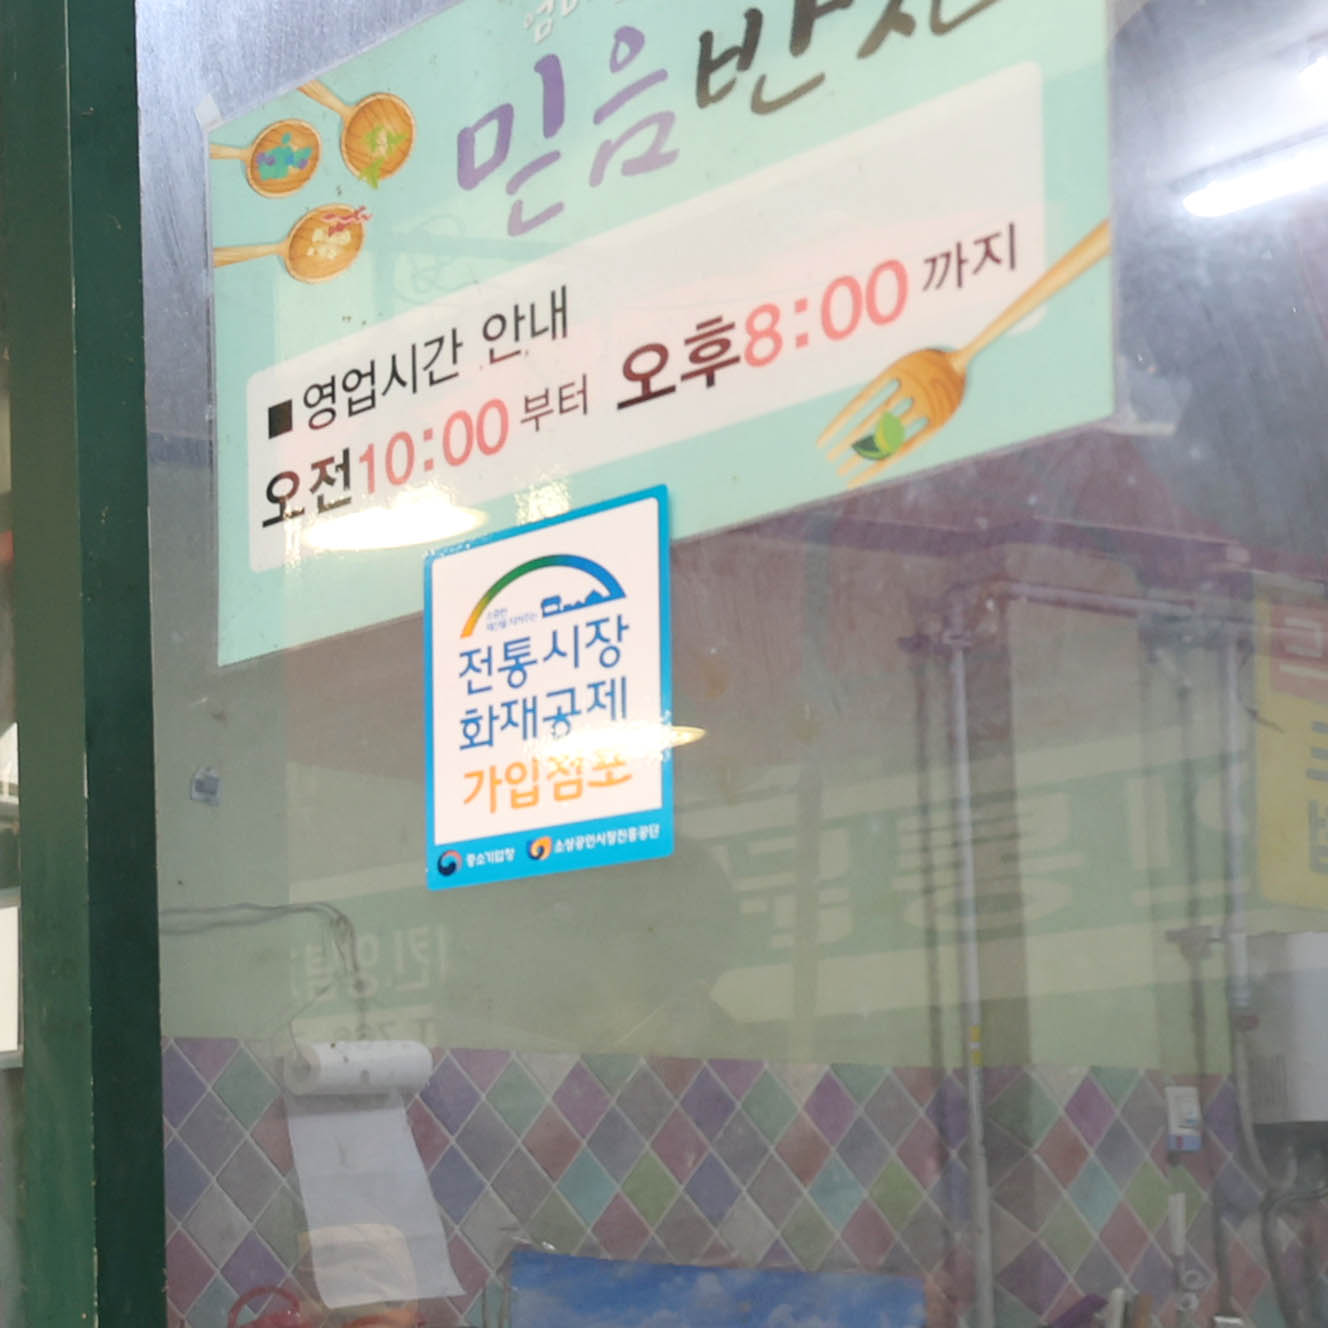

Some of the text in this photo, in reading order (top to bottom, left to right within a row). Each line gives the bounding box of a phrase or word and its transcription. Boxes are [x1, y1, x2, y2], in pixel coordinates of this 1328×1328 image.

[303, 285, 568, 431] 영업시간 안내
[520, 374, 588, 432] 부터
[922, 222, 1016, 291] 까지
[459, 614, 630, 696] 전통시장
[459, 676, 628, 751] 화재공제
